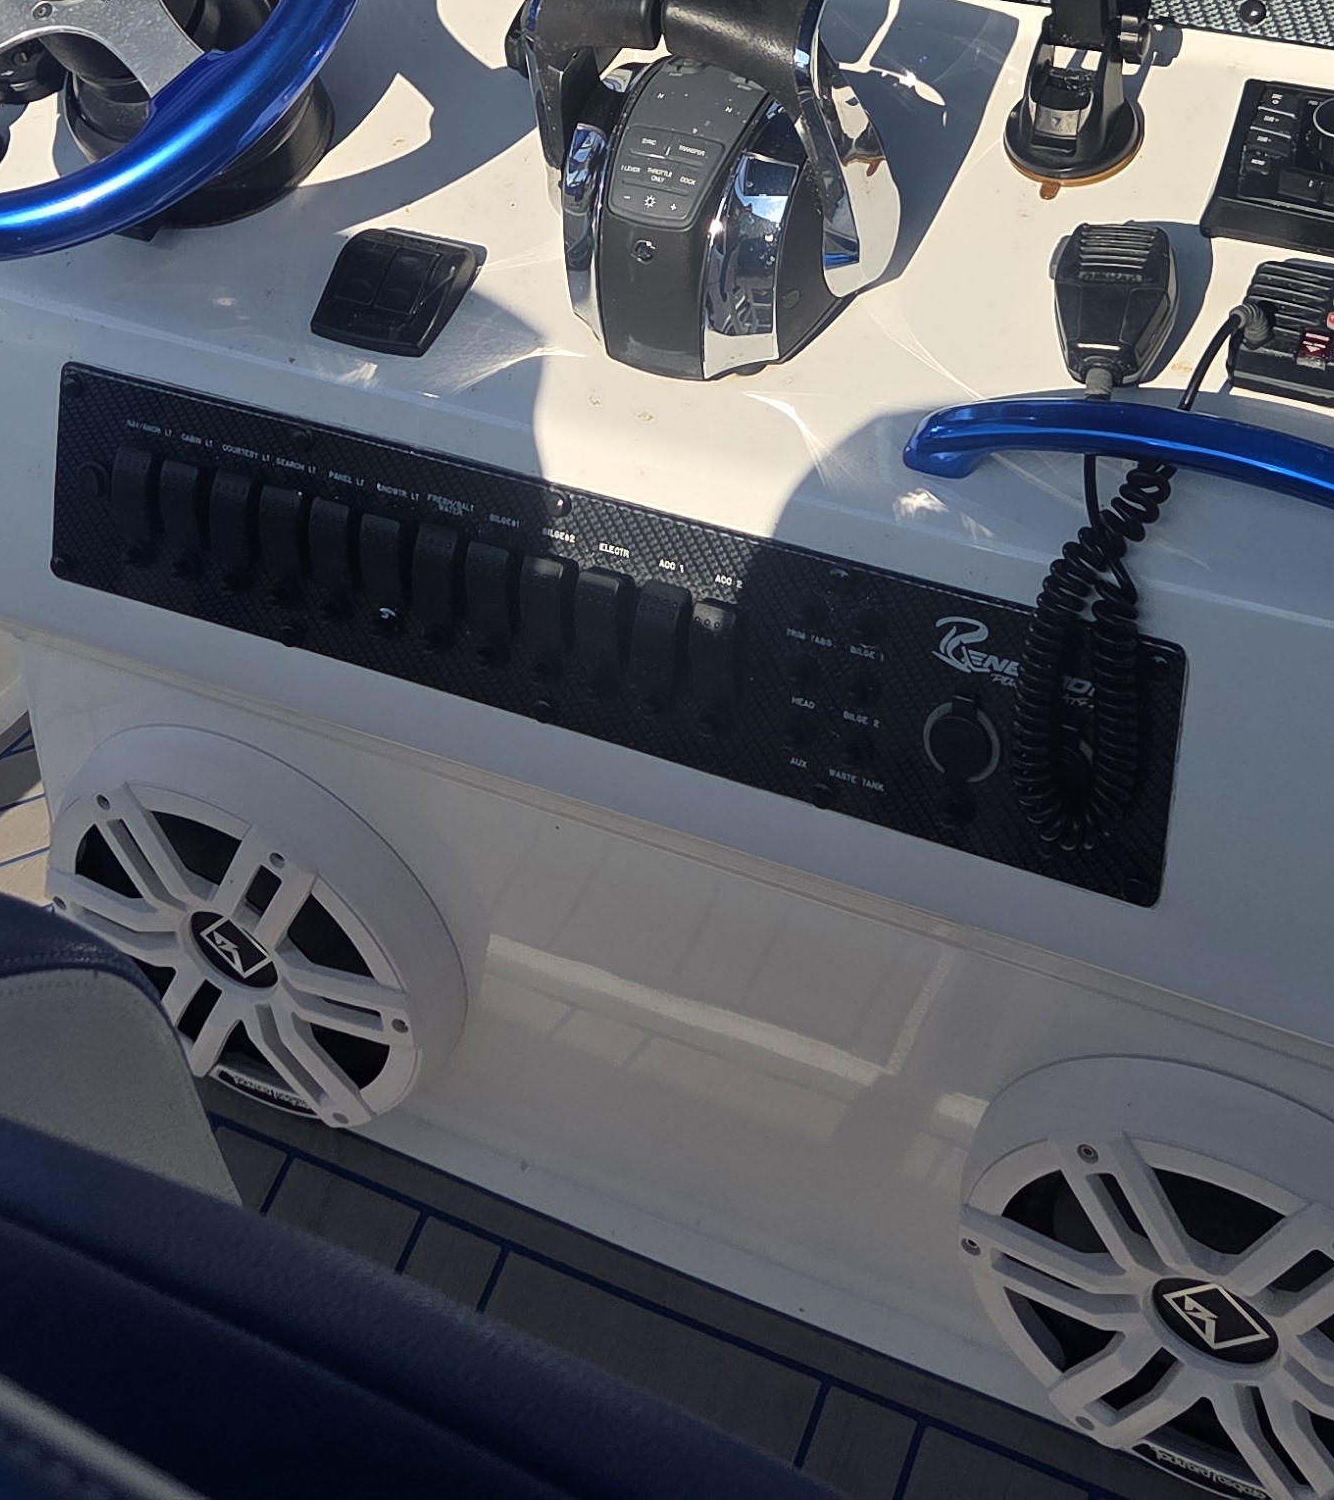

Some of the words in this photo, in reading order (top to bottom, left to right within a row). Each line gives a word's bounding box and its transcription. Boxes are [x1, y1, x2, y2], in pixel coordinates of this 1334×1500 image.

[181, 432, 202, 445] CABIN
[222, 443, 258, 460] COURTESY
[276, 456, 305, 471] SEARCH
[329, 470, 353, 484] PANEL
[437, 503, 463, 517] WATER
[599, 542, 630, 558] ELECTR
[659, 558, 676, 571] ACC
[714, 574, 732, 586] ACC
[850, 645, 875, 660] BILGE
[791, 696, 816, 710] HEAD
[843, 710, 869, 726] BILGE
[790, 757, 808, 769] AUX
[828, 768, 857, 784] WASTE
[862, 778, 885, 792] TANK
